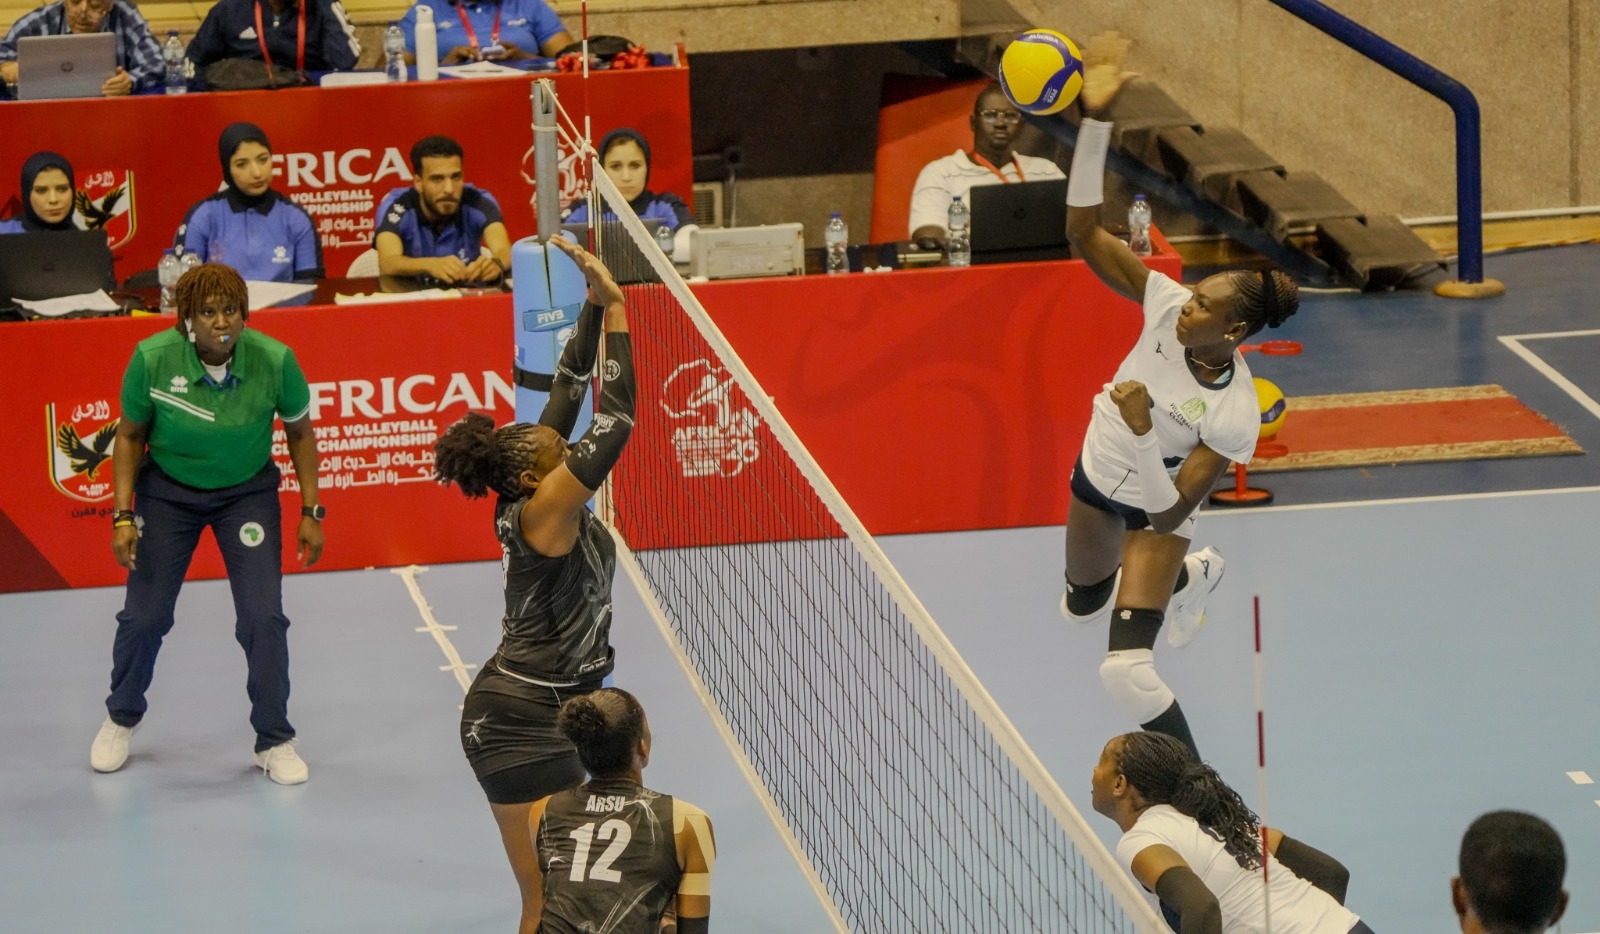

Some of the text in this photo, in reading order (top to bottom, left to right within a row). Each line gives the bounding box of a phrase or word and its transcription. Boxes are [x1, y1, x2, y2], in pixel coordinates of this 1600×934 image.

[218, 146, 414, 192] FRICA
[290, 189, 374, 203] VOLLEYBALL
[303, 201, 374, 215] PIONSHIP
[537, 309, 565, 324] FIVB
[273, 370, 514, 421] FRICAN
[343, 419, 437, 437] VOLLEYBALL
[317, 432, 437, 452] CHAMPIONSHIP
[585, 795, 626, 812] ARSU
[569, 818, 632, 883] 12
